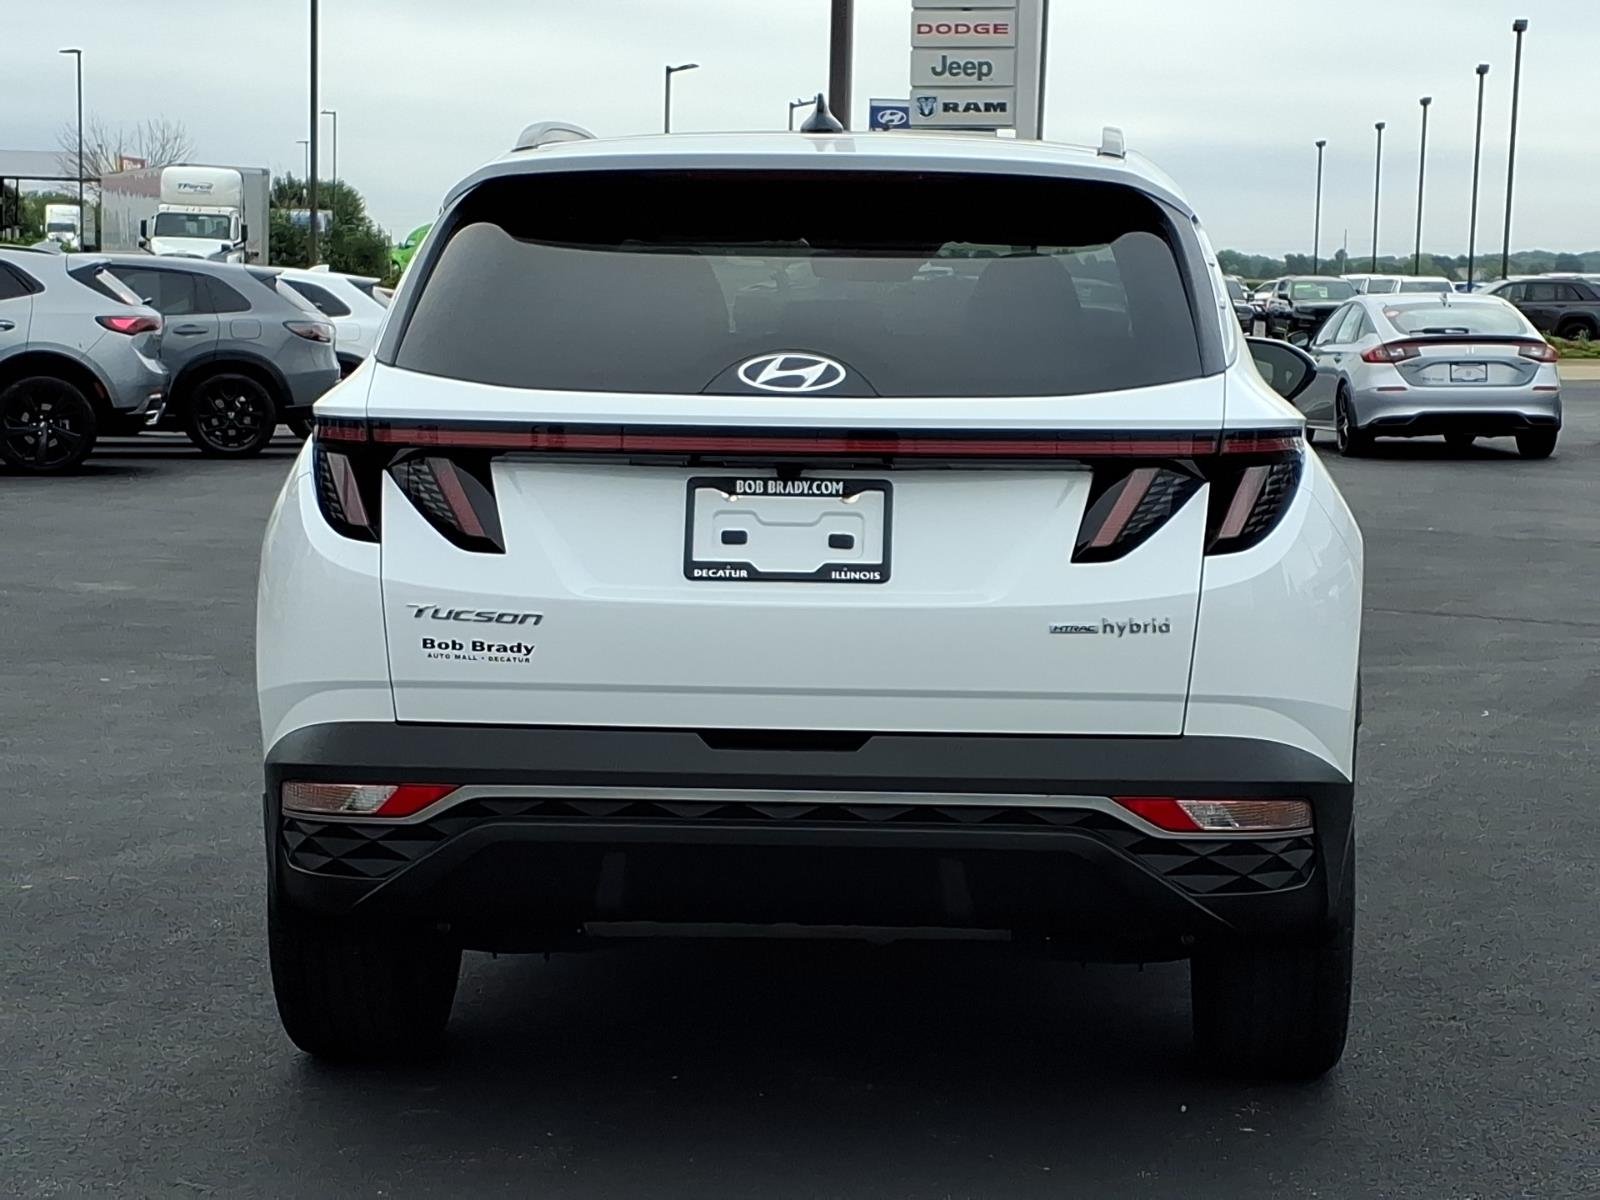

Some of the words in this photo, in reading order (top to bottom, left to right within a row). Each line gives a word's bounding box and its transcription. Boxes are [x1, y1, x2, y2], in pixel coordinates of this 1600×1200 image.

[916, 23, 1009, 35] DODGE
[931, 55, 993, 81] Jeep
[942, 102, 1007, 113] RAM
[736, 480, 764, 493] BOB
[767, 480, 844, 495] BRADY.COM
[694, 568, 748, 578] DECATUR
[831, 570, 880, 580] ILLINOIS
[1102, 617, 1170, 638] hybrid
[421, 637, 464, 651] Bob
[471, 640, 535, 656] Brady
[427, 652, 451, 660] AUTO
[454, 653, 477, 661] MALL
[488, 655, 530, 664] DECATUR
